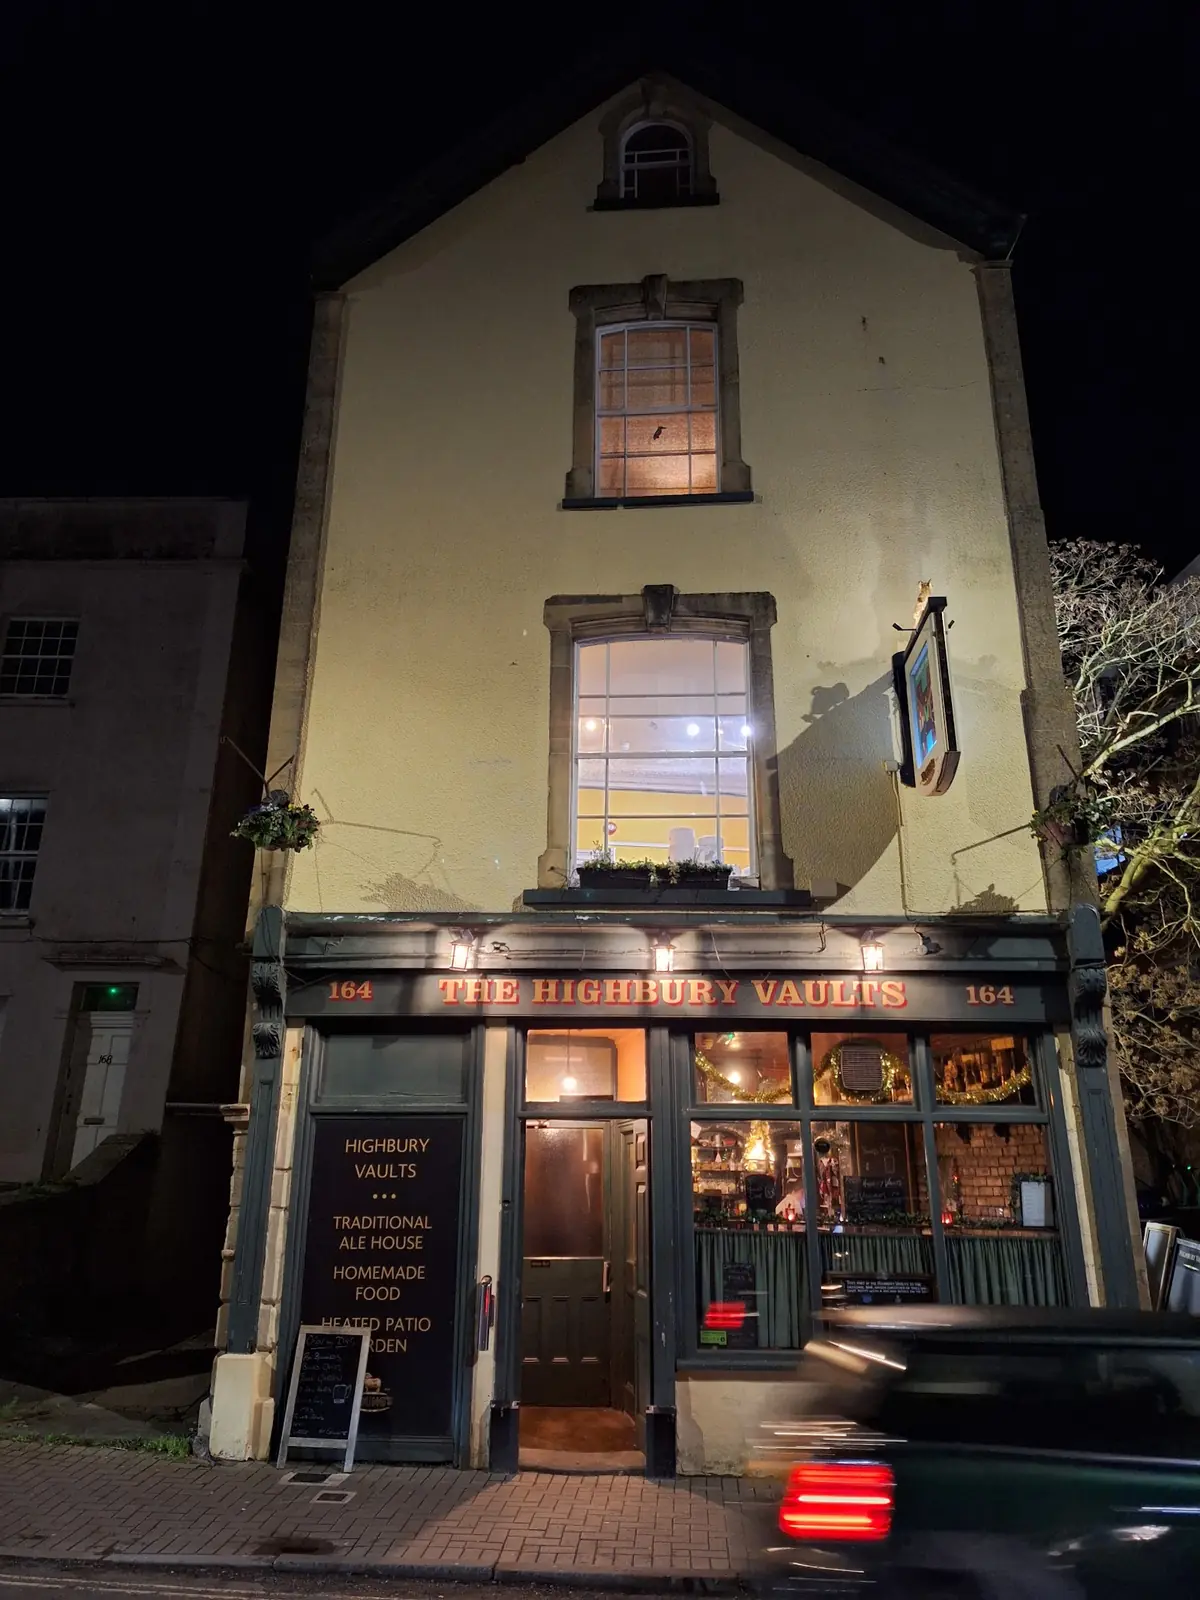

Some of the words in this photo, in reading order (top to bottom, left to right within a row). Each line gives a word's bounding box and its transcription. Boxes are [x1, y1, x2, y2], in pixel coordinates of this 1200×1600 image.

[328, 979, 374, 1001] 164
[438, 978, 519, 1004] THE
[531, 978, 738, 1005] HIGHBURY
[751, 979, 907, 1007] VAULTS
[965, 985, 1014, 1008] 164
[98, 1054, 113, 1065] 168
[345, 1138, 430, 1154] HIGHBURY
[354, 1163, 417, 1179] VAULTS
[333, 1215, 433, 1230] TRADITIONAL
[339, 1236, 367, 1250] ALE
[371, 1235, 423, 1250] HOUSE
[333, 1265, 426, 1280] HOMEMADE
[355, 1286, 401, 1301] FOOD
[321, 1317, 381, 1332] HEATED
[385, 1317, 432, 1332] PATIO
[368, 1338, 408, 1353] RDEN
